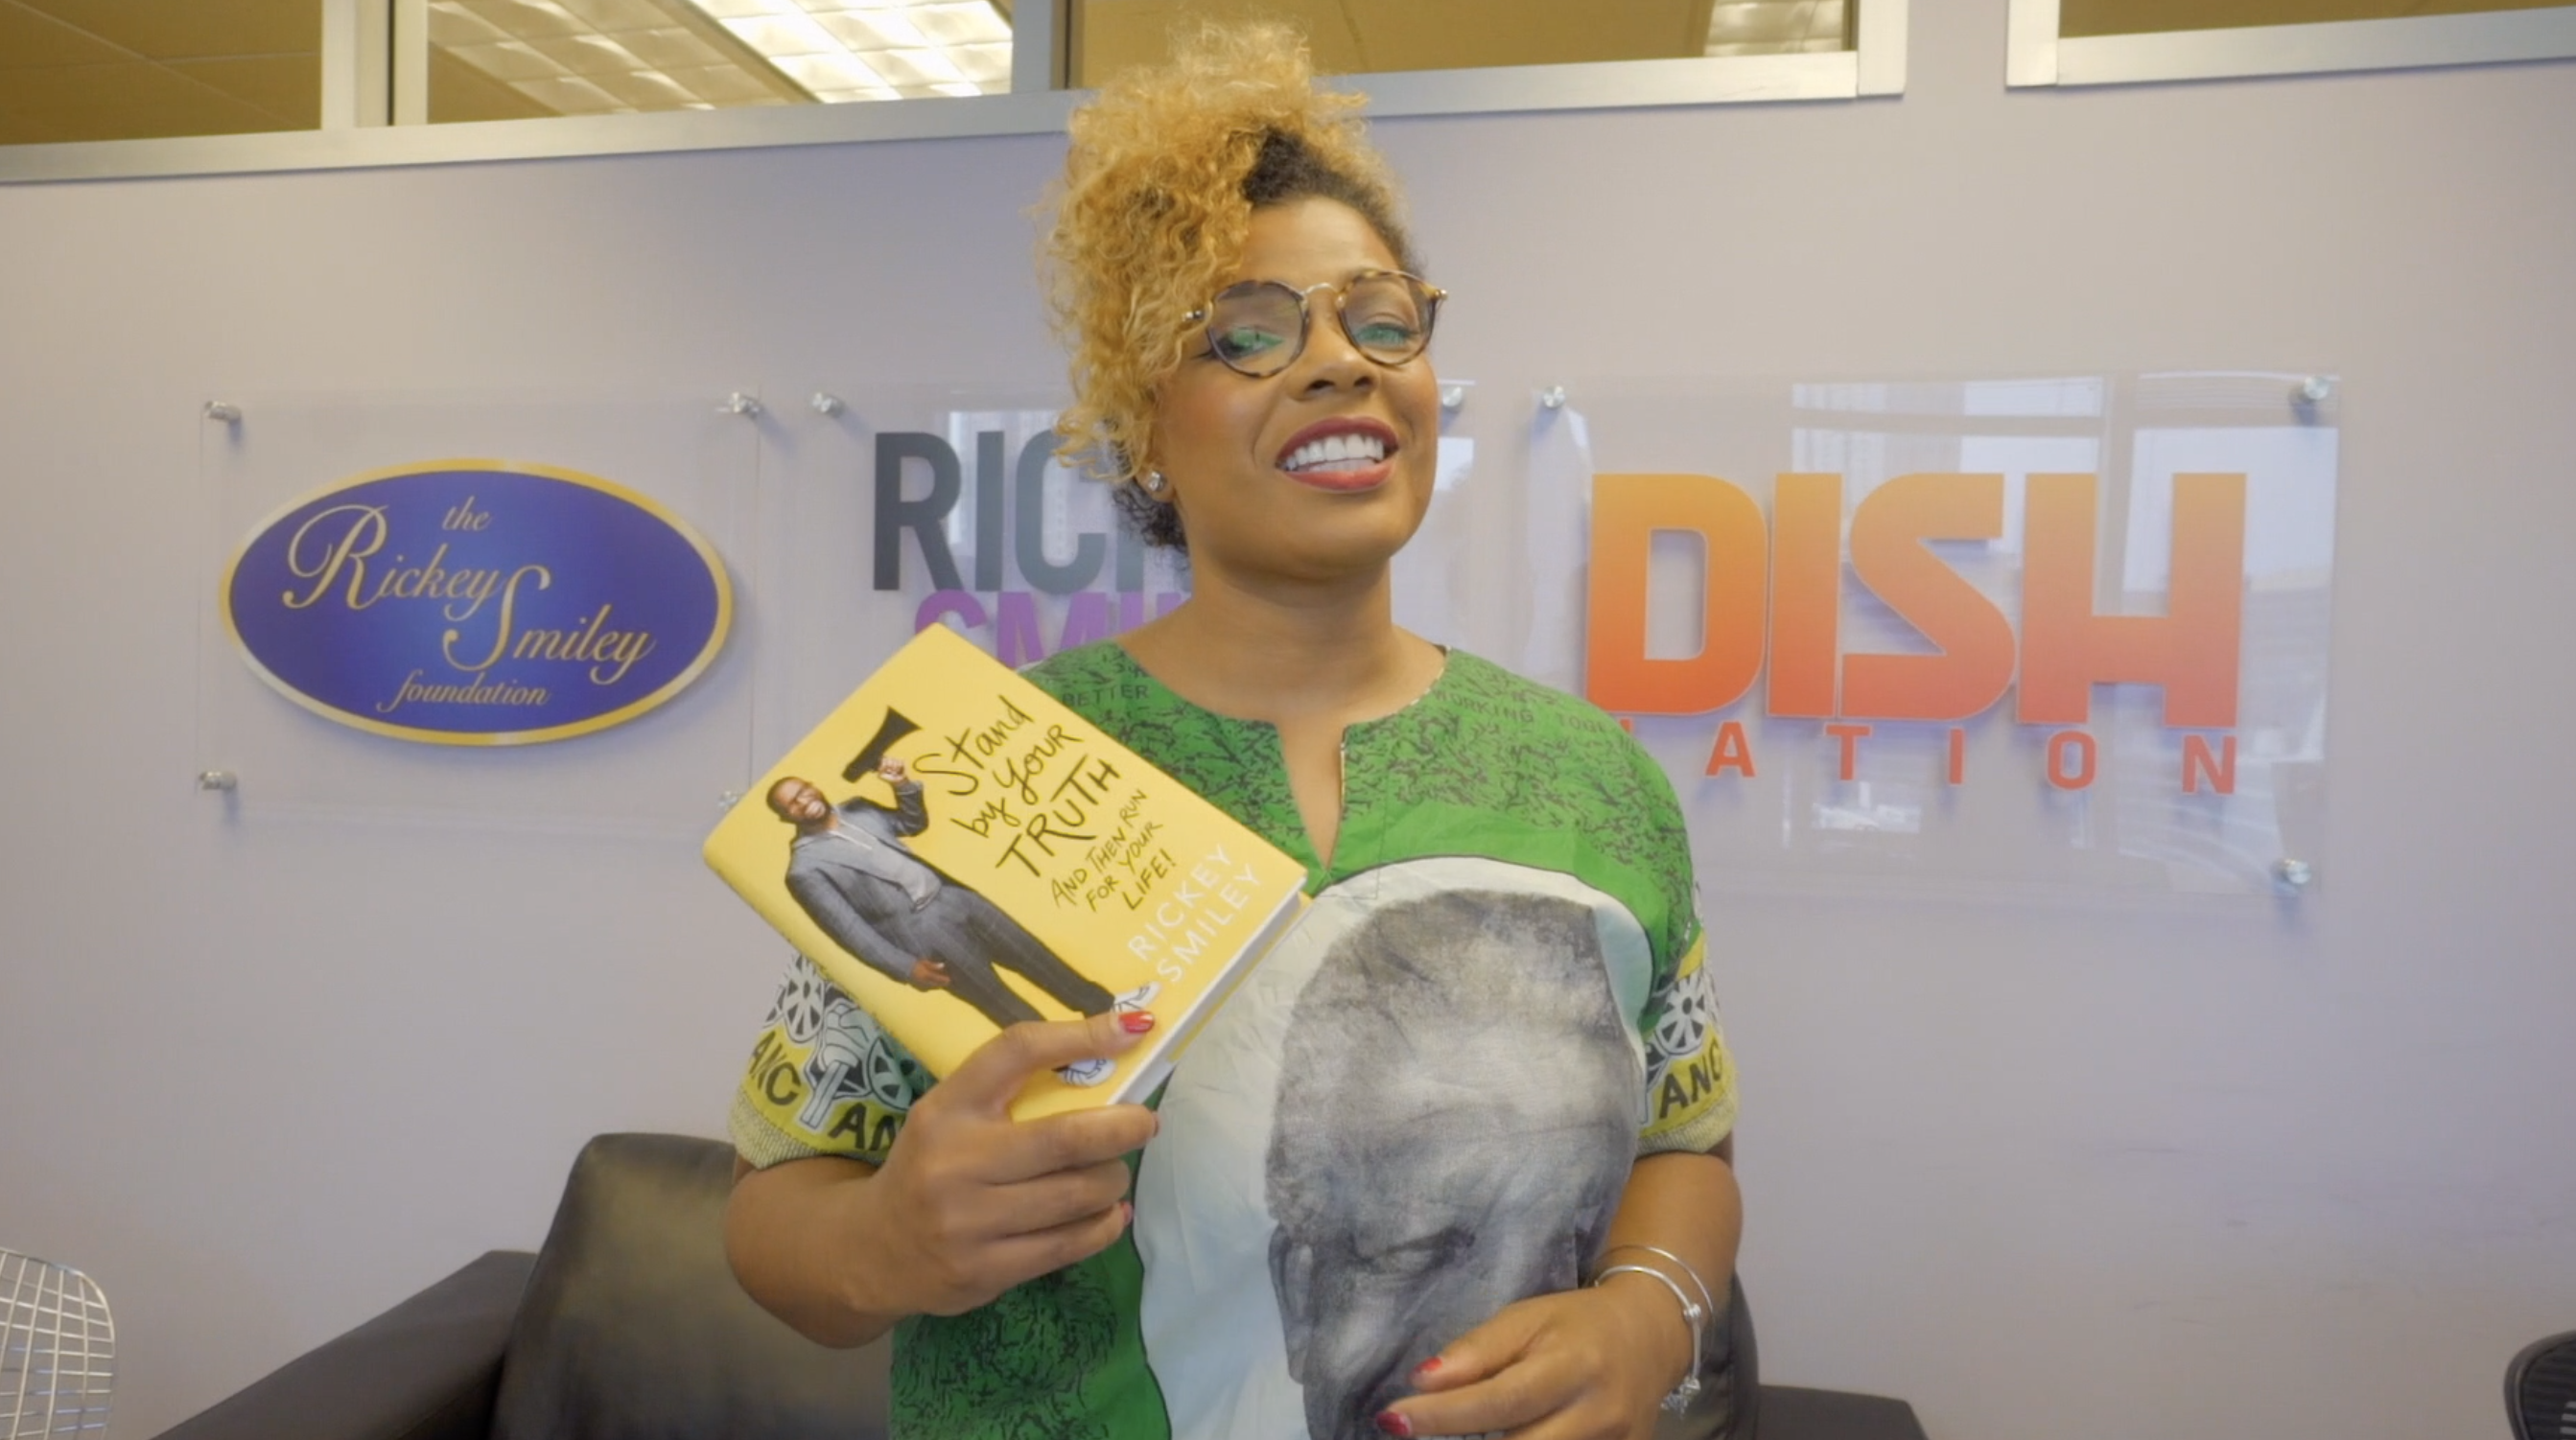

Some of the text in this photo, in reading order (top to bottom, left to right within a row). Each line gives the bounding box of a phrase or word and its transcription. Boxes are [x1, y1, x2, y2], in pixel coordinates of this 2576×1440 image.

[441, 496, 491, 532] the
[282, 503, 501, 621] Rickey
[1584, 472, 2247, 729] DISH
[442, 565, 656, 685] Smiley
[376, 669, 551, 713] foundation
[1061, 683, 1149, 708] BETTER
[911, 693, 1035, 797] Stand
[1619, 718, 2237, 795] ATION
[948, 796, 1021, 839] by
[995, 753, 1121, 878] TRUTH
[1051, 788, 1148, 908] AND THEN RUN
[1086, 821, 1164, 913] FOR YOUR
[1121, 848, 1177, 912] LIFE!
[1127, 841, 1232, 963] RICKEY
[1157, 862, 1261, 985] SMILEY
[749, 1030, 802, 1106] ANC
[1658, 1036, 1722, 1120] ANC
